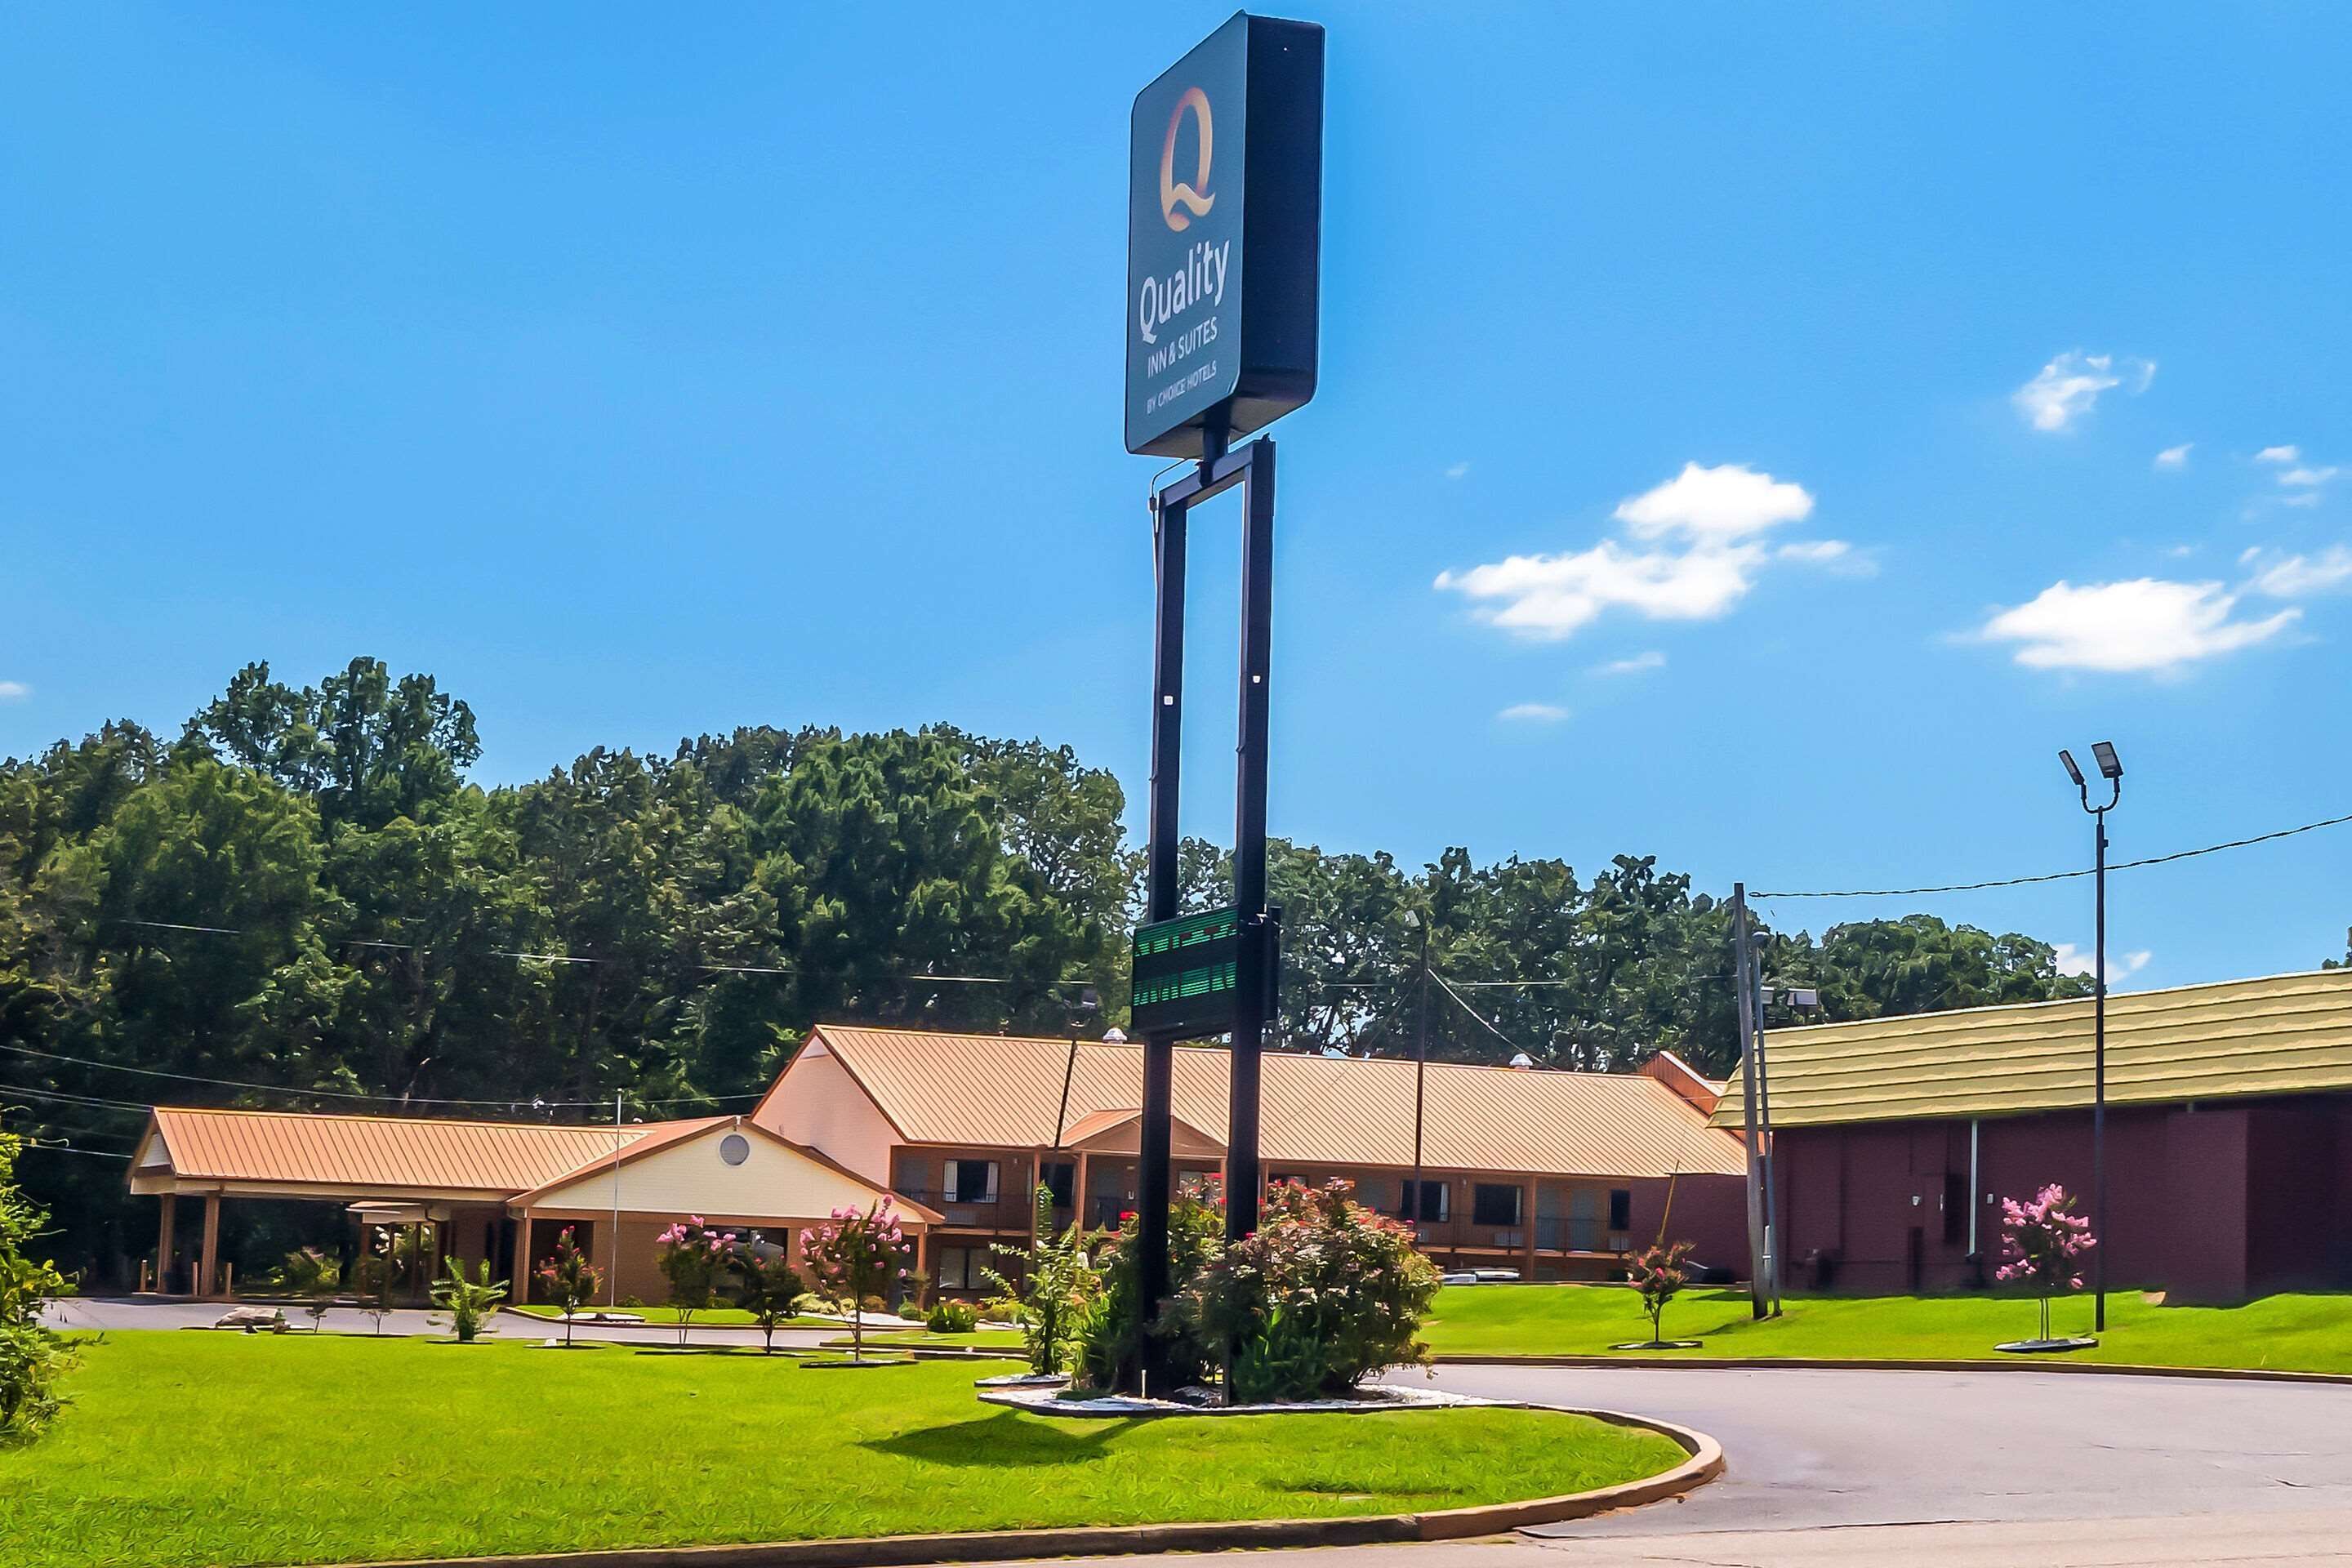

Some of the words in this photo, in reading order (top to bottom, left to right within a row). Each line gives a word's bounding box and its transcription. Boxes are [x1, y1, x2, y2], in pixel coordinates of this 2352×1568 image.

[1160, 86, 1215, 232] Q
[1139, 239, 1230, 345] Quality
[1147, 346, 1167, 379] INN
[1168, 341, 1176, 365] &
[1178, 315, 1218, 359] SUITES
[1147, 396, 1156, 414] BY
[1158, 378, 1186, 407] CHOICE
[1187, 359, 1217, 387] HOTELS
